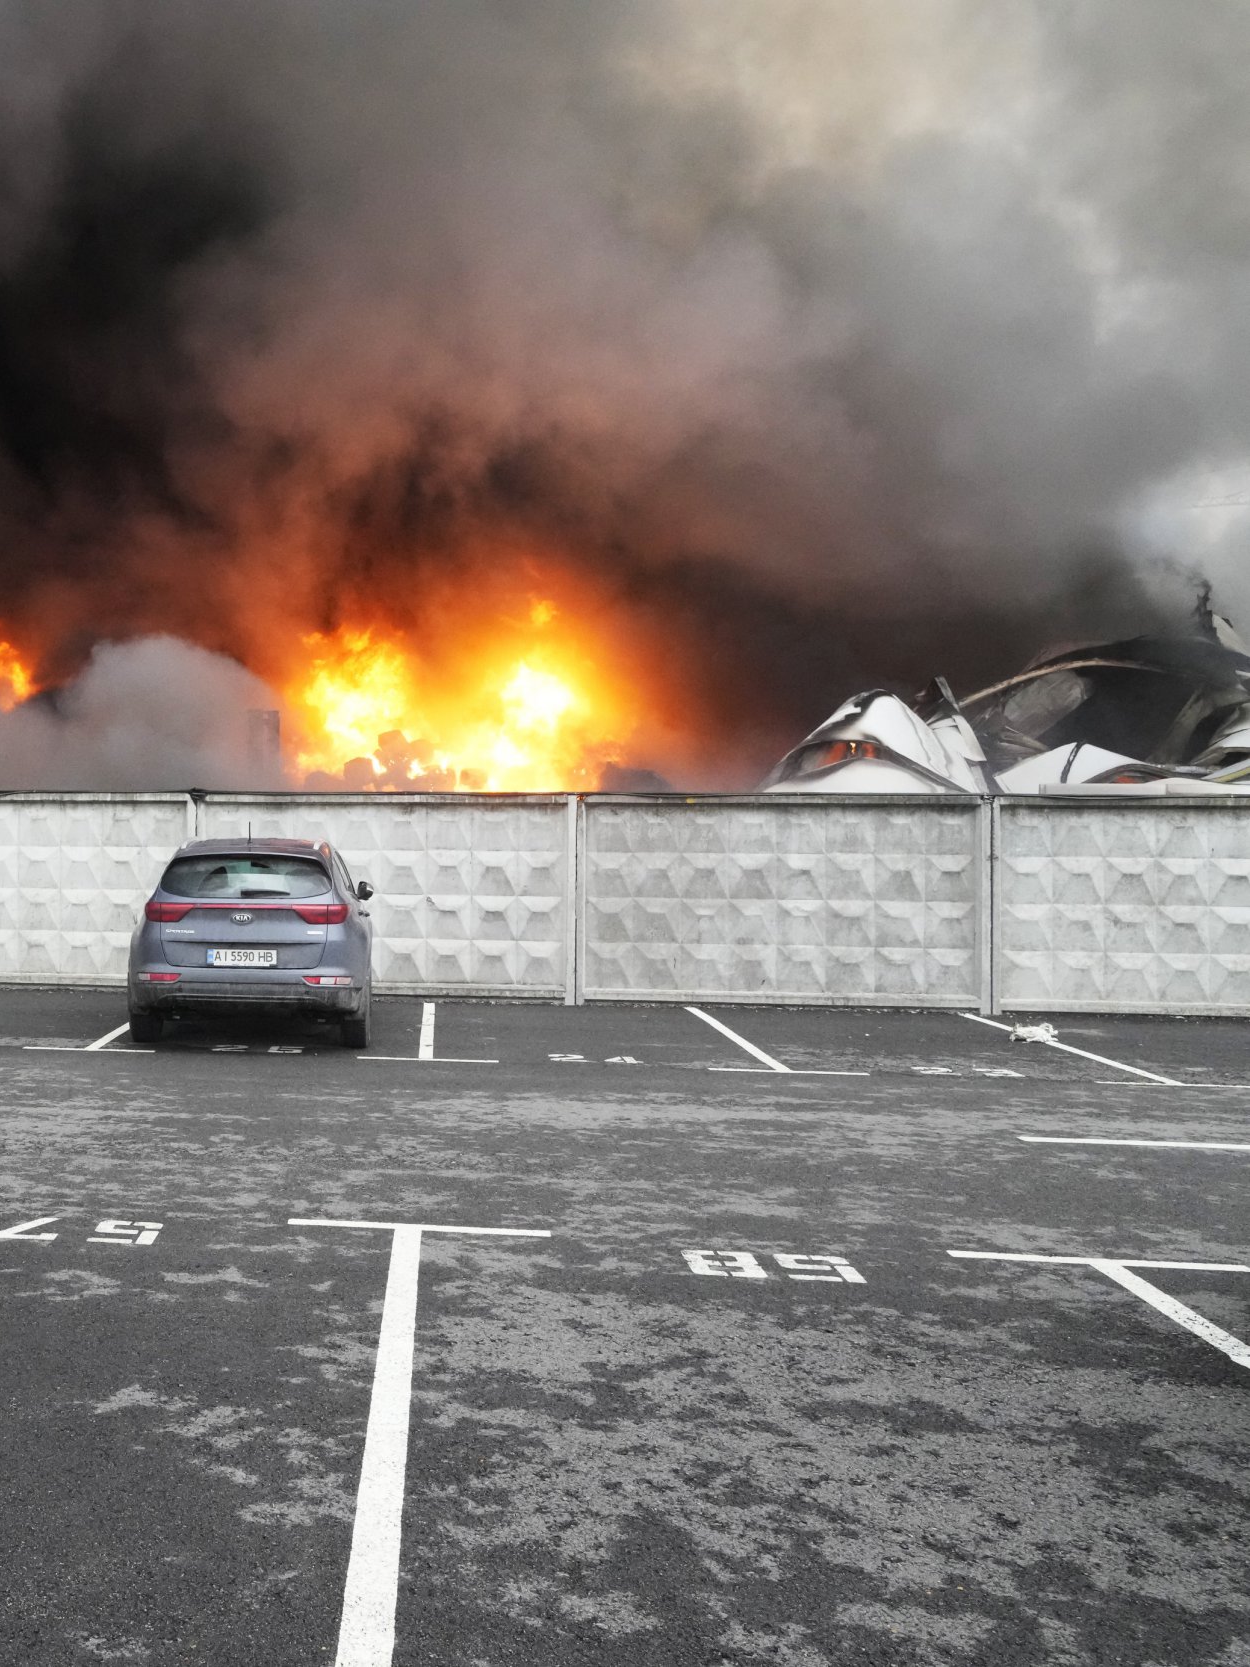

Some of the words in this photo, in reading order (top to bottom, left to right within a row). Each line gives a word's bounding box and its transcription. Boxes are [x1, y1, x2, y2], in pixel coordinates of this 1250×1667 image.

[231, 951, 255, 962] 5590
[258, 951, 274, 962] HB
[211, 1044, 306, 1054] 25
[547, 1053, 644, 1064] 24
[681, 1249, 868, 1284] 58
